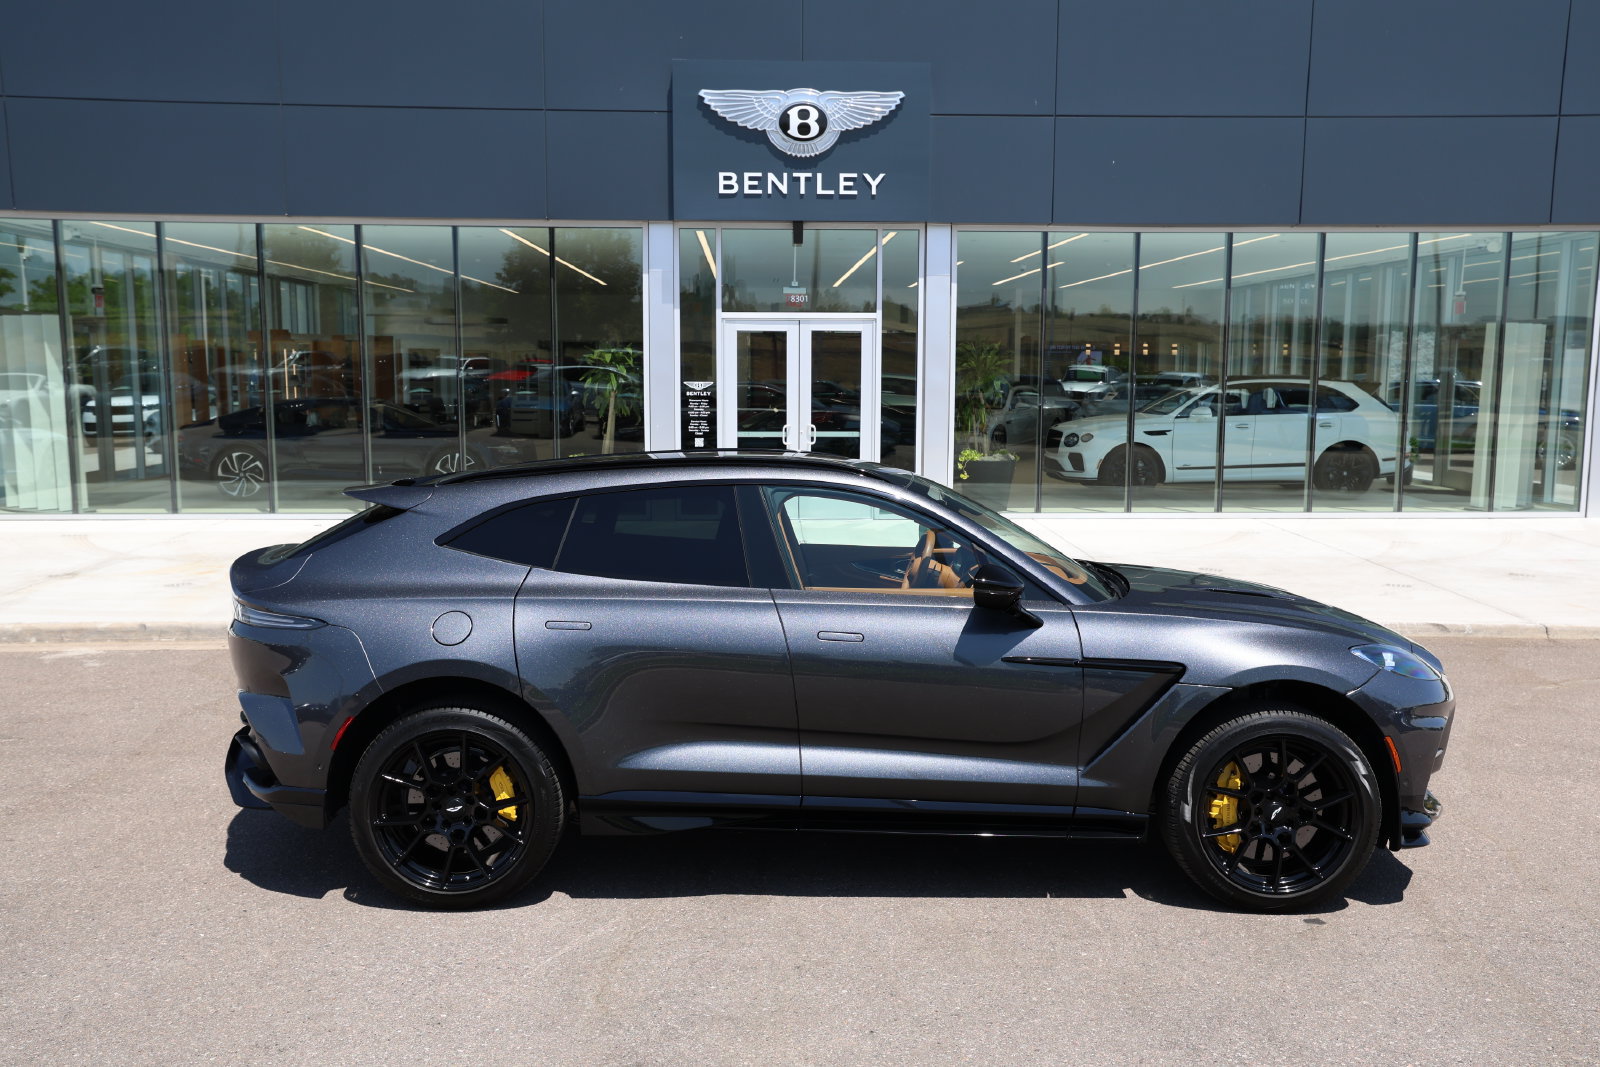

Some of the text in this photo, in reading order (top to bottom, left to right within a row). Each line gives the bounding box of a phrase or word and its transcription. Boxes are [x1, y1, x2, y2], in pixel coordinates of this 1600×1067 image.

[787, 105, 819, 139] B
[718, 172, 886, 195] BENTLEY
[791, 294, 808, 303] 8301
